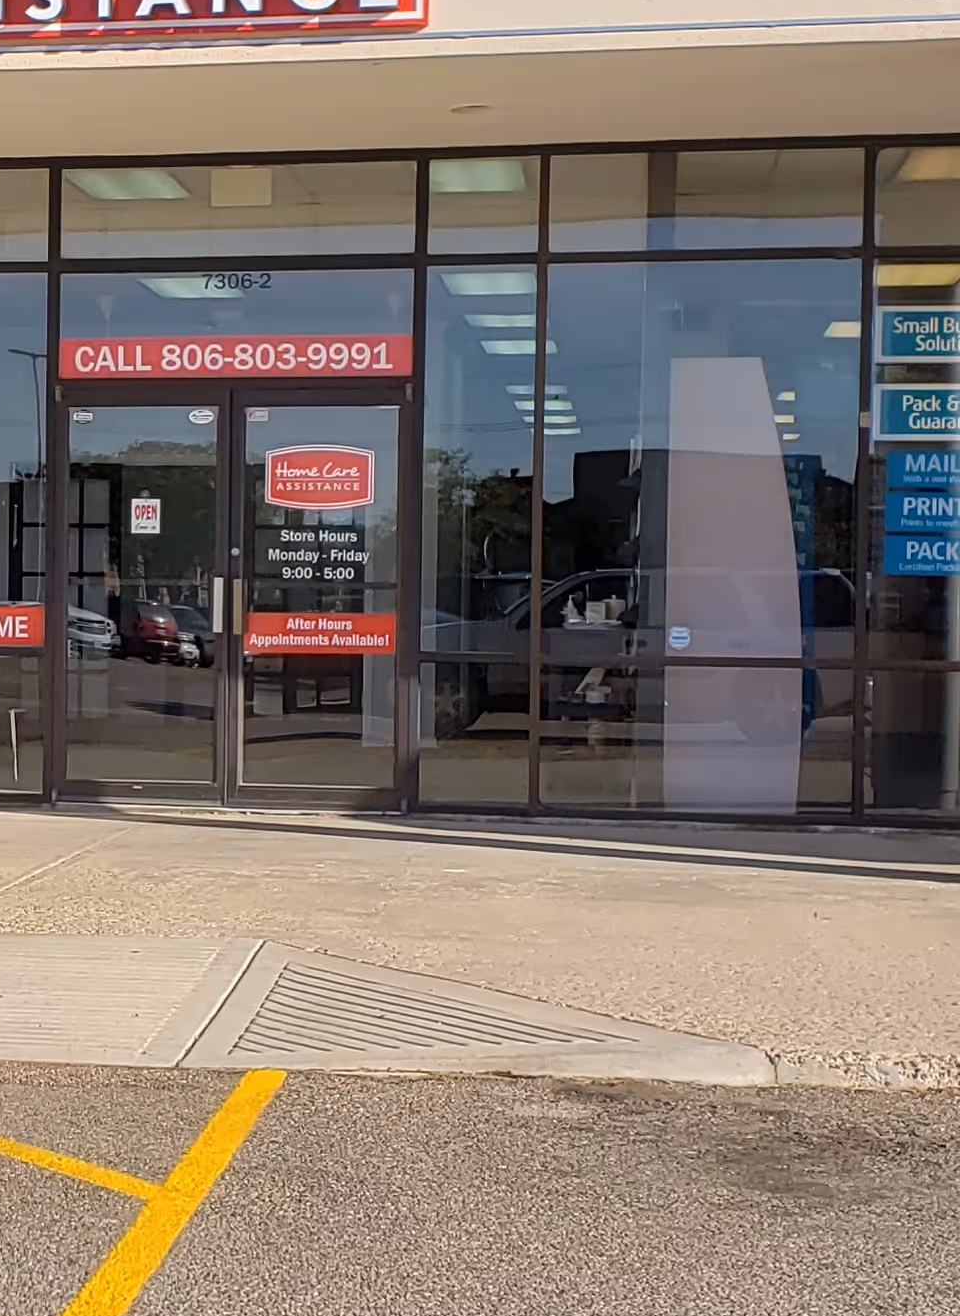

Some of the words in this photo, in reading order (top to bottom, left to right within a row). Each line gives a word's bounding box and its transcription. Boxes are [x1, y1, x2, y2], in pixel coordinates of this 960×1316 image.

[201, 273, 272, 290] 7306-2
[893, 316, 939, 334] Small
[74, 345, 152, 372] CALL
[161, 342, 393, 370] 806-803-9991
[902, 394, 942, 412] Pack
[908, 412, 960, 429] Guara
[275, 461, 320, 478] Home
[322, 462, 360, 478] Care
[276, 482, 360, 491] ASSISTANCE
[134, 504, 158, 521] OPEN
[280, 529, 315, 542] Store
[319, 529, 358, 542] Hours
[268, 548, 320, 564] Monday
[330, 549, 370, 564] Friday
[906, 541, 960, 560] PACK
[282, 567, 313, 579] 9:00
[323, 567, 355, 579] 5:00
[286, 617, 316, 630] After
[318, 618, 353, 630] Hours
[249, 633, 329, 647] Appointments
[331, 634, 390, 646] Available!
